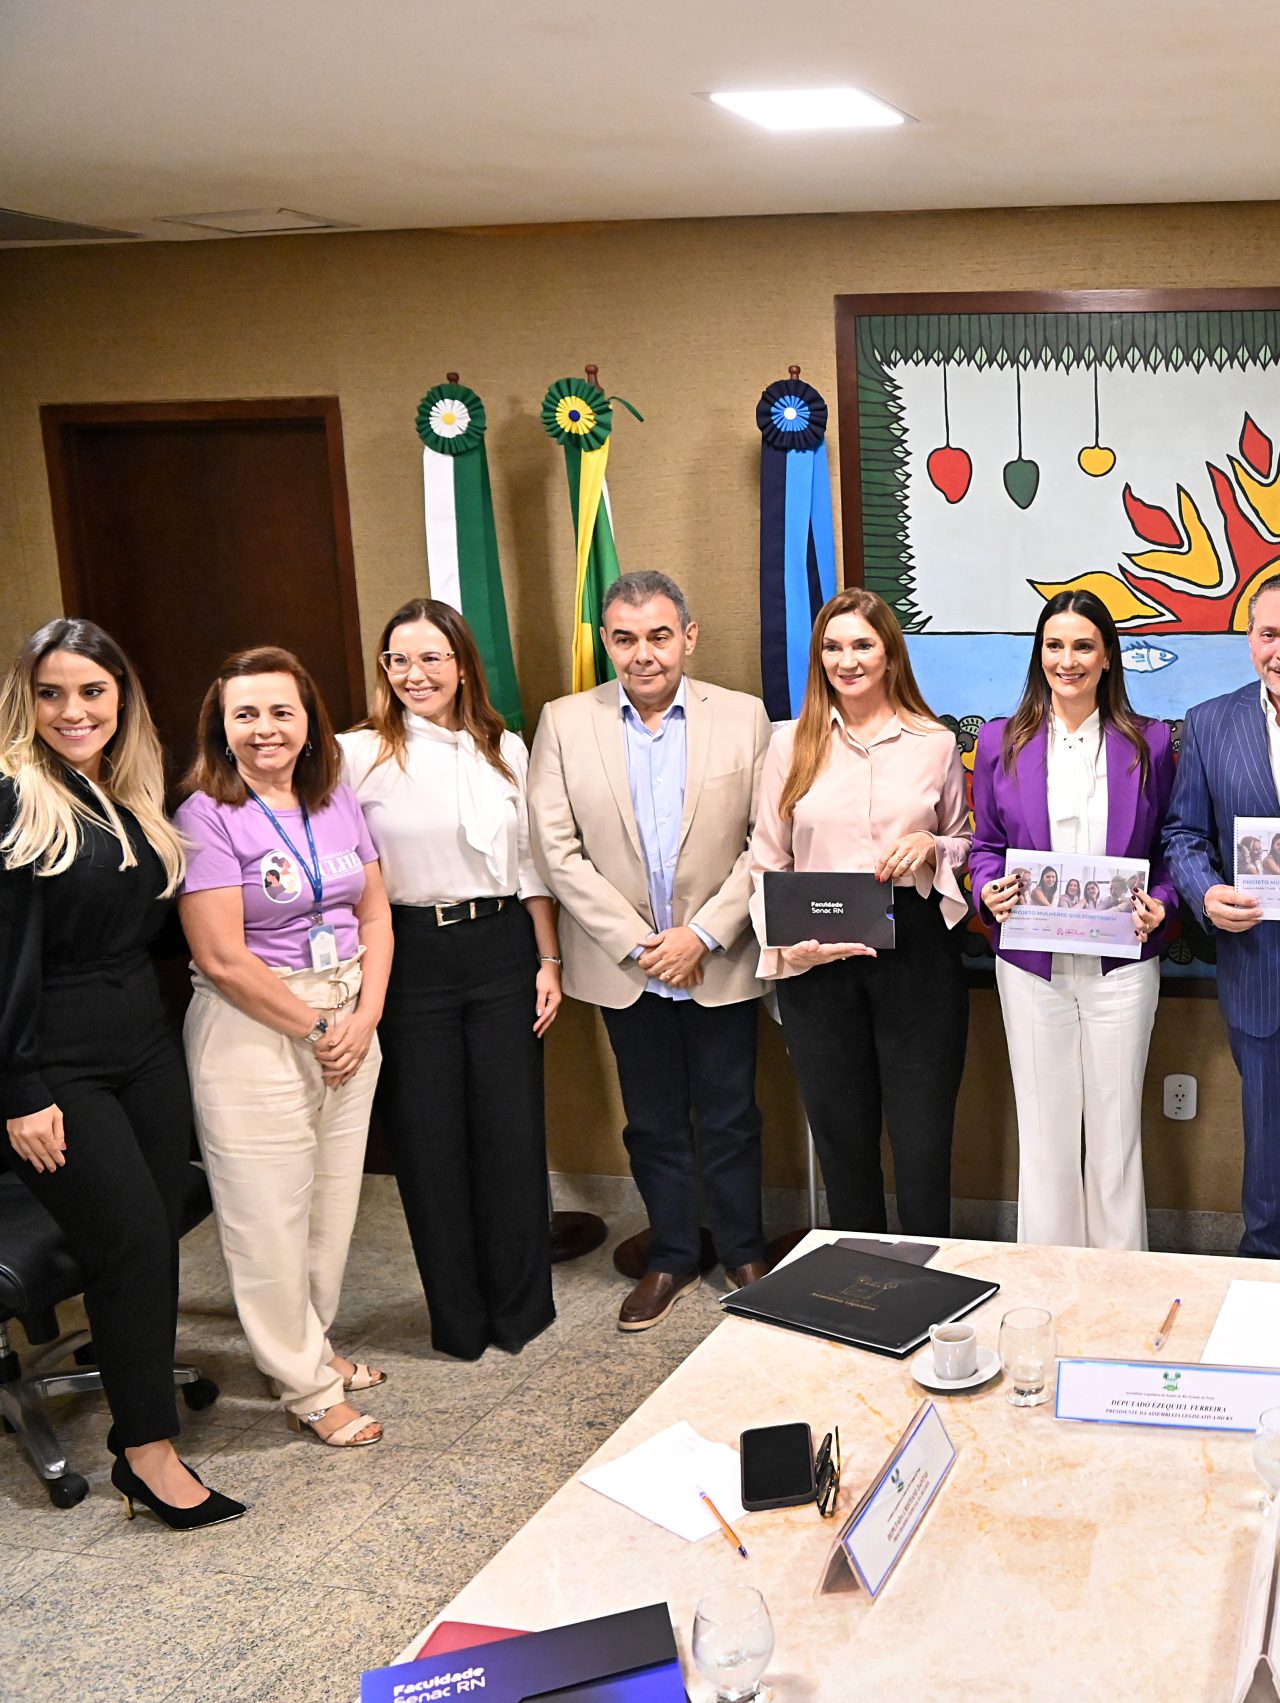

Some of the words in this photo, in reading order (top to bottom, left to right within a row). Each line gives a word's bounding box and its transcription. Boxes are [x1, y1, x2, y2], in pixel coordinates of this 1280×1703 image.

[1111, 1399, 1151, 1408] DEPUTADO
[1151, 1402, 1188, 1410] EZEQUIEL
[1190, 1404, 1227, 1413] FERREIRA
[393, 1667, 485, 1697] Faculdade
[393, 1686, 451, 1703] Senac
[456, 1676, 486, 1694] RN
